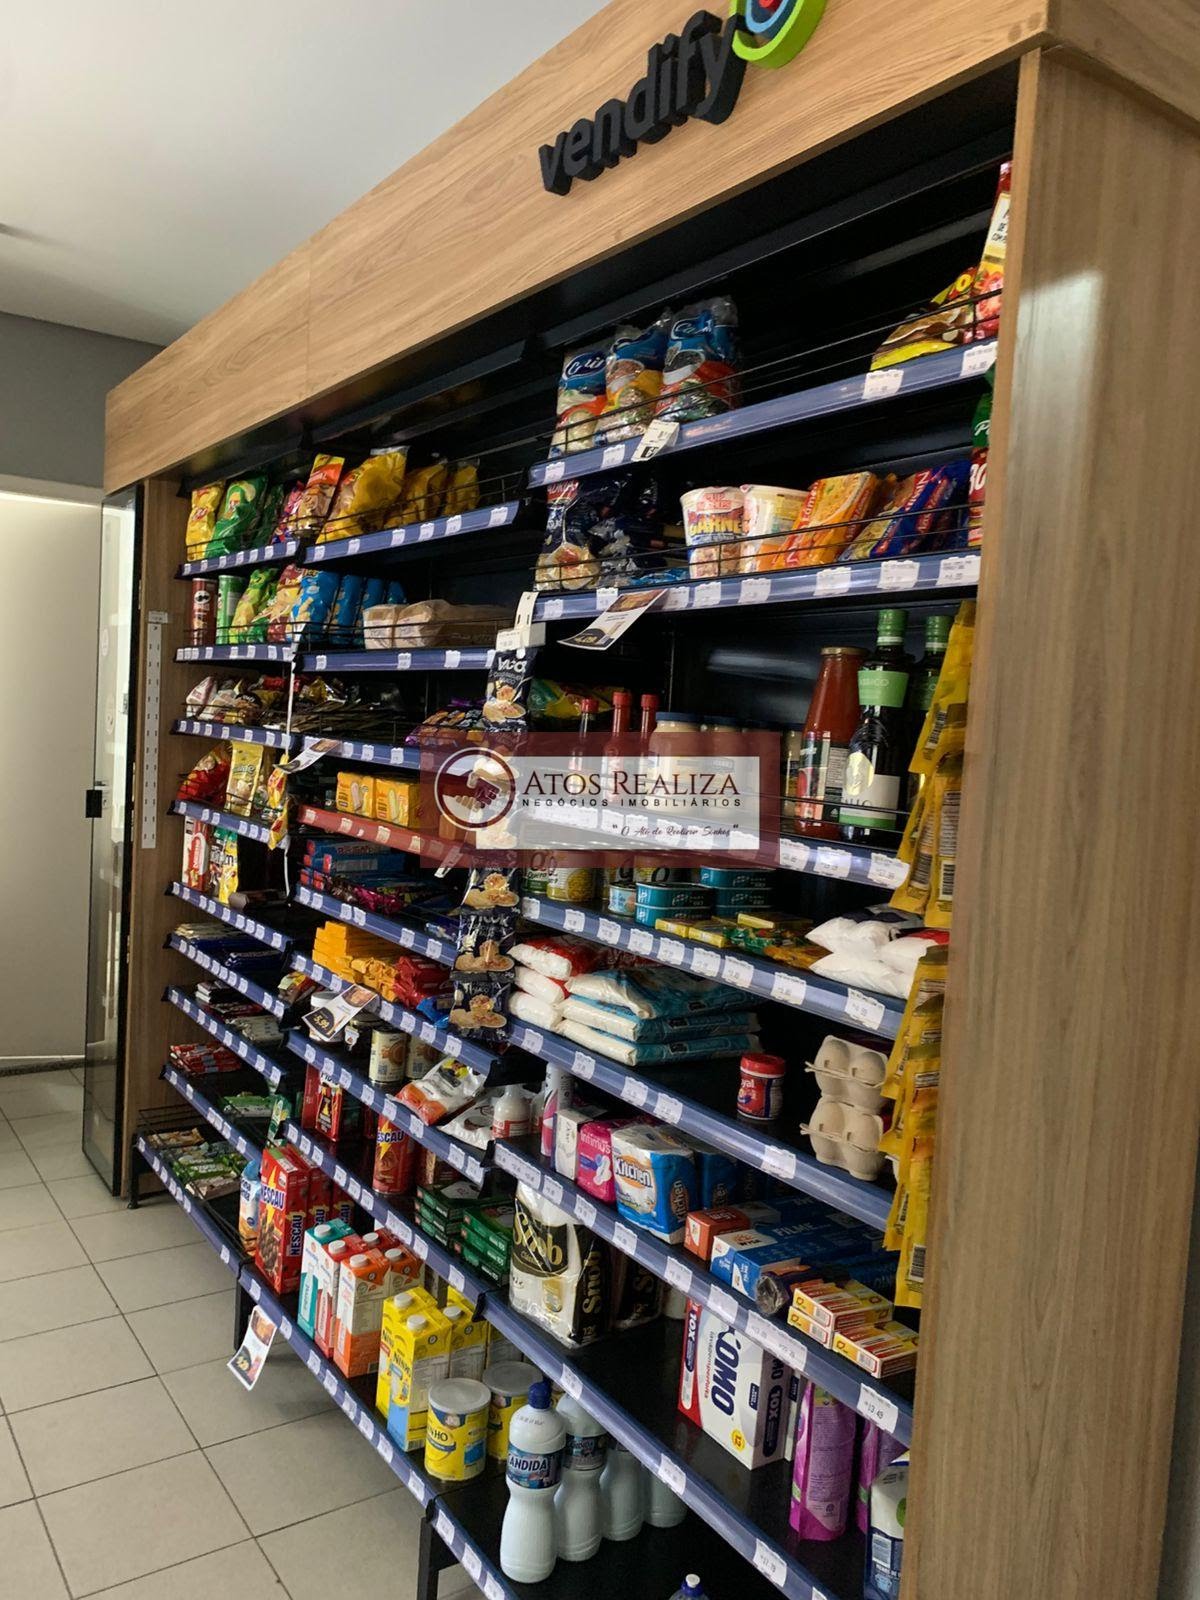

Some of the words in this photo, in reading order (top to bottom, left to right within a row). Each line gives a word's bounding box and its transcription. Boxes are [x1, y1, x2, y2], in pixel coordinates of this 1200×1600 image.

[539, 9, 747, 196] vendify
[376, 1130, 405, 1143] ESCAU
[615, 1157, 653, 1188] Kitchen
[290, 1214, 303, 1256] NESCAU
[711, 1335, 741, 1416] OMO
[509, 1457, 547, 1472] ANDIDA
